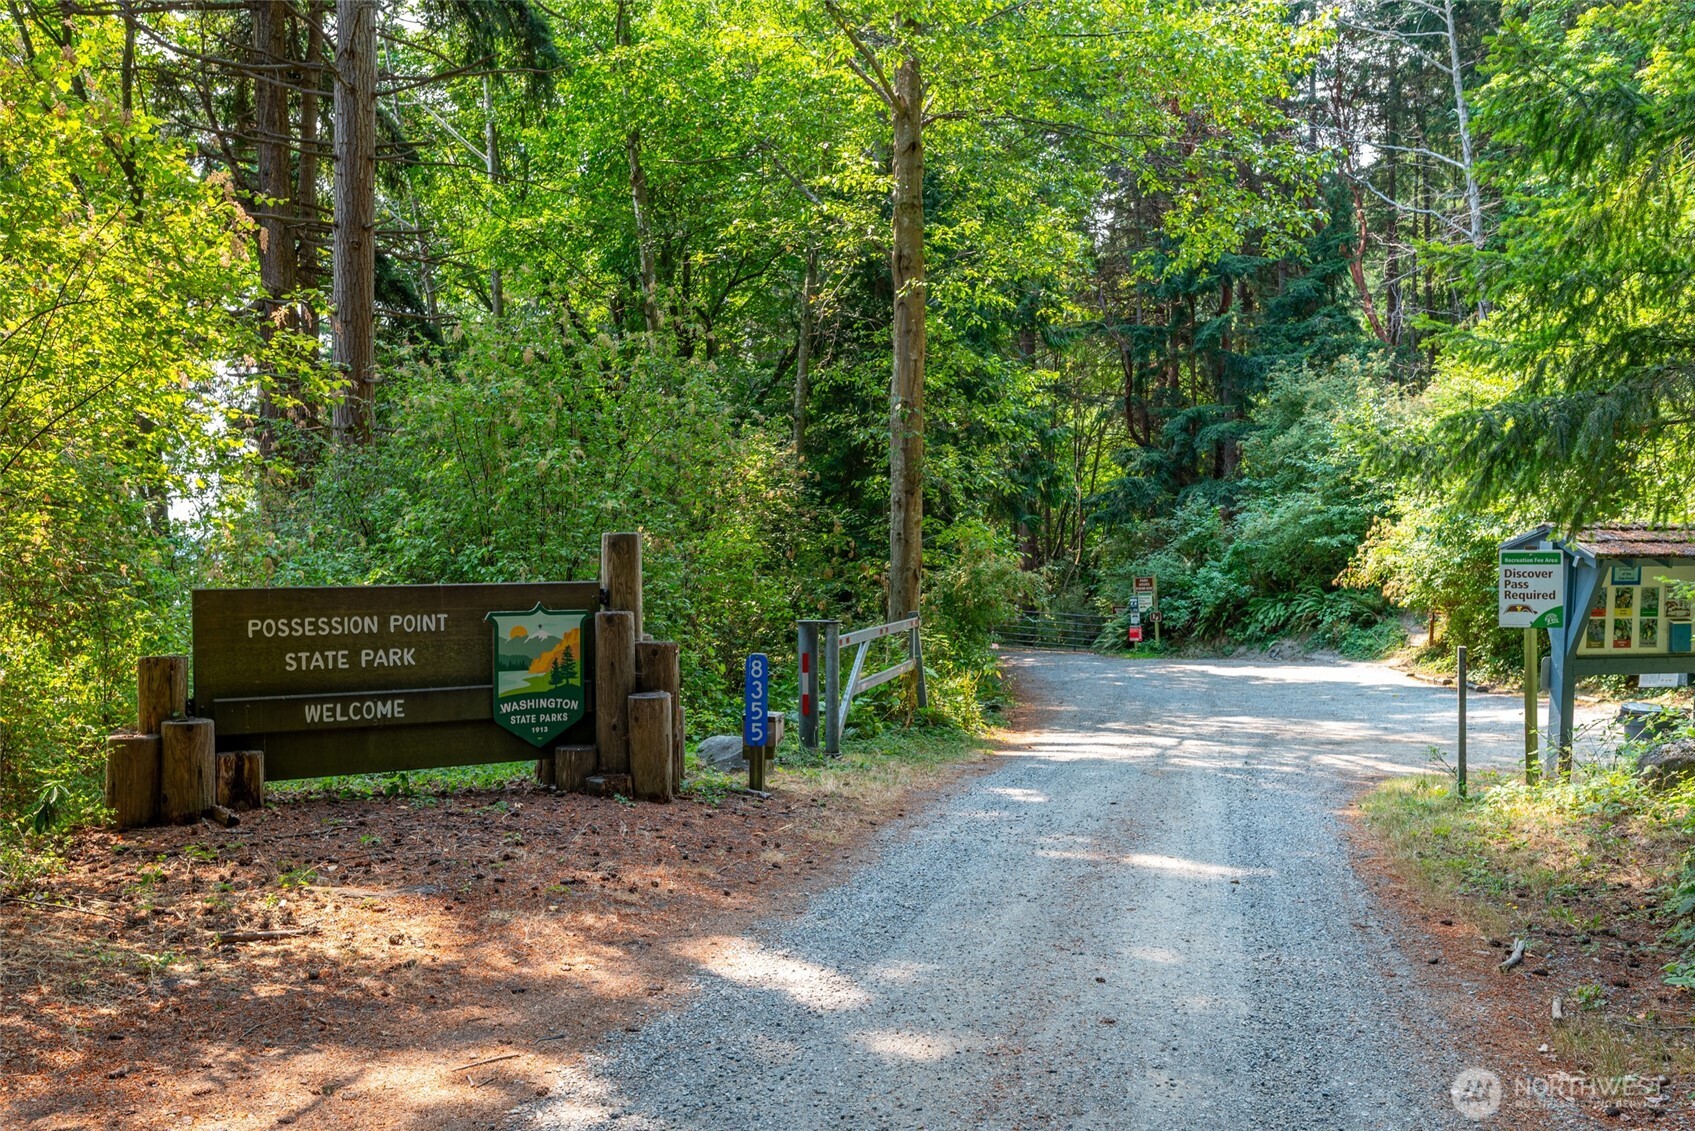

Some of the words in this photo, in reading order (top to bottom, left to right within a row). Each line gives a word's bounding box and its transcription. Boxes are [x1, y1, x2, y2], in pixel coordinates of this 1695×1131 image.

[1504, 568, 1553, 578] Discover
[1504, 580, 1529, 589] Pass
[1504, 590, 1556, 602] Required
[247, 614, 379, 638] POSSESSION
[389, 612, 448, 634] POINT
[284, 650, 350, 672] STATE
[360, 647, 416, 668] PARK
[500, 698, 579, 713] WASHINGTON
[750, 659, 763, 741] 8355
[304, 699, 405, 724] WELCOME
[510, 714, 536, 725] STATE
[539, 712, 568, 723] PARKS
